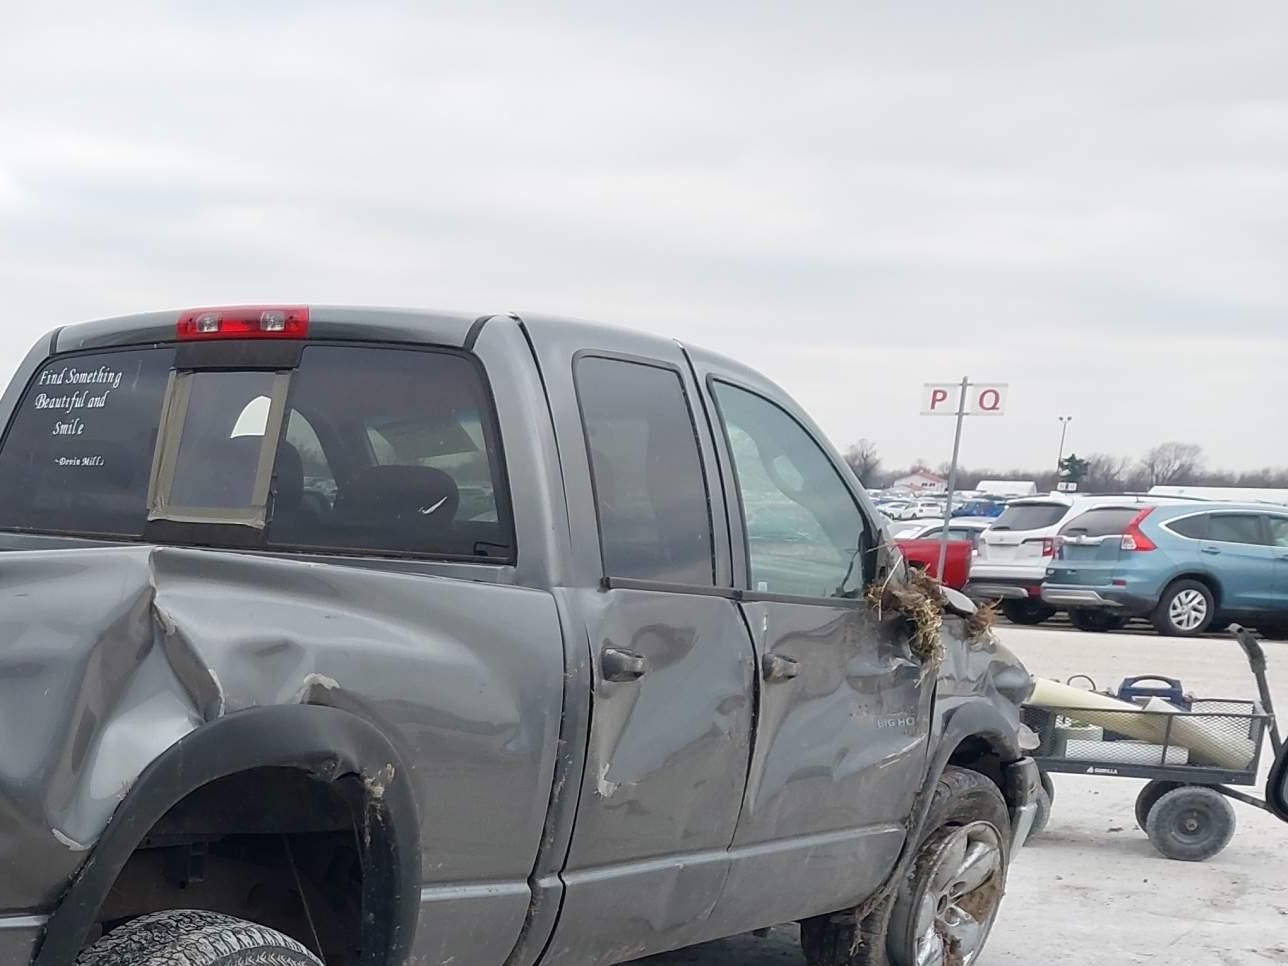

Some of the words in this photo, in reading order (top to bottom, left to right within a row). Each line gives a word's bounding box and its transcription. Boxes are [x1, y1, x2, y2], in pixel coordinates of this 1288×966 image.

[39, 367, 68, 385] Find
[65, 366, 123, 389] Something
[34, 390, 89, 414] Beautiful
[87, 390, 111, 408] and
[930, 389, 948, 410] P
[978, 389, 1001, 411] Q
[52, 418, 85, 435] Smile
